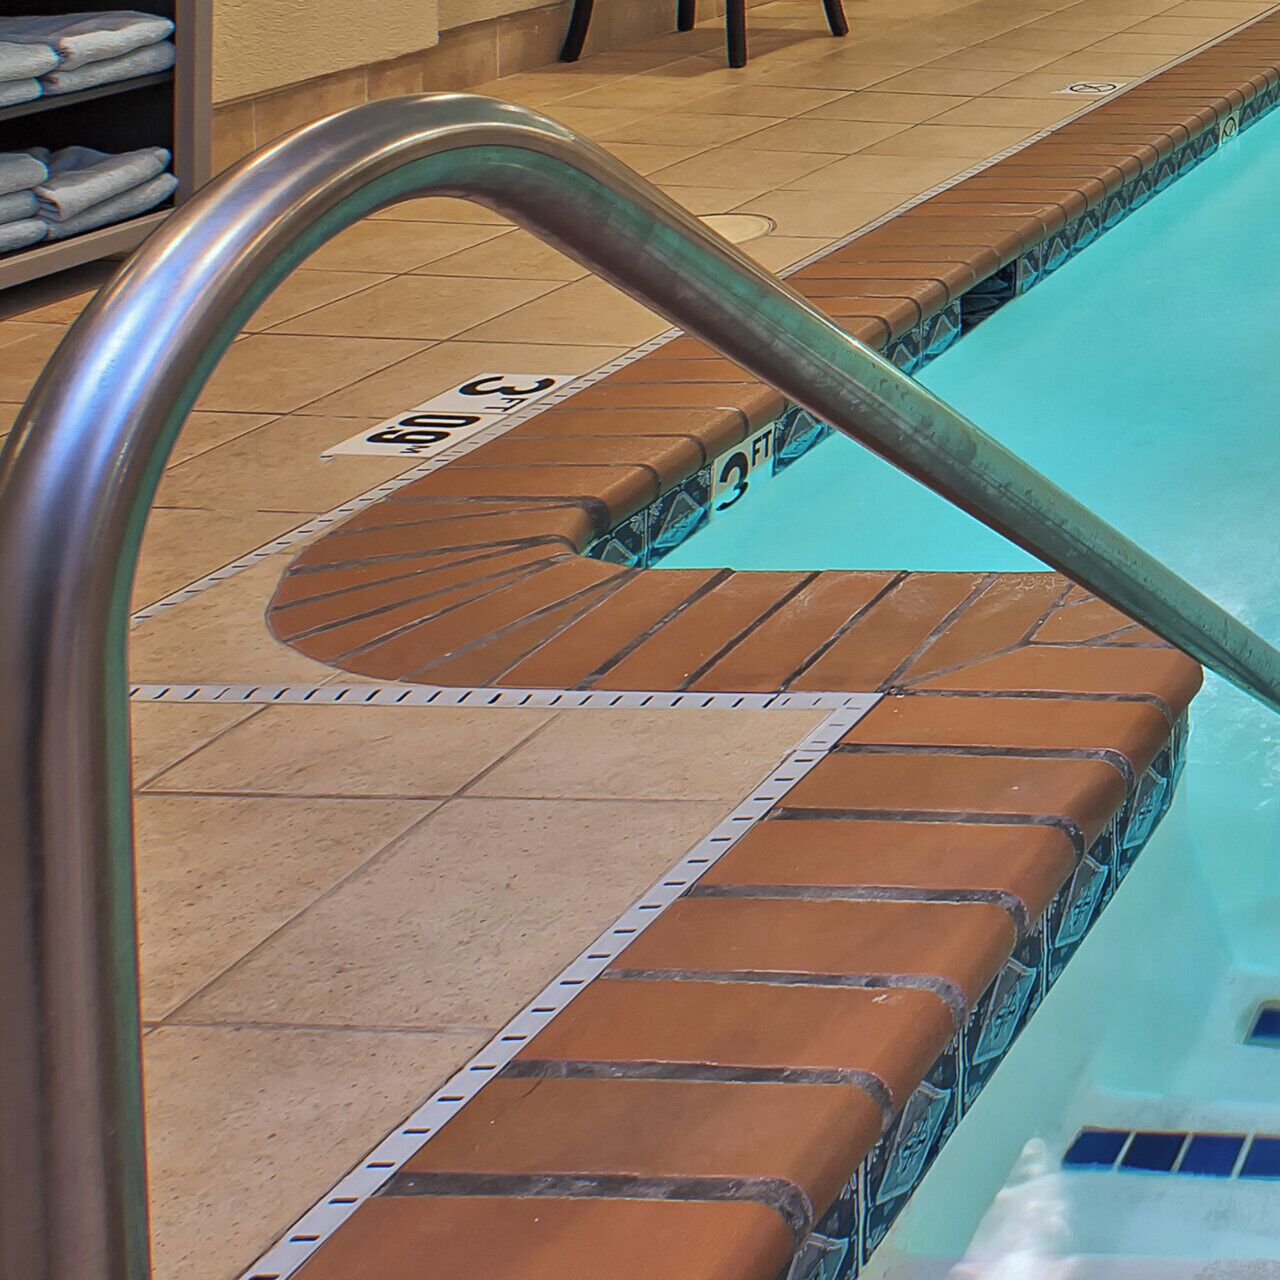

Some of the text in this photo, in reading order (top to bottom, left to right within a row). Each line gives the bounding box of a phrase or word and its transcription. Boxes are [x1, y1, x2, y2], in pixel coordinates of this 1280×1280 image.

[458, 375, 556, 412] 3 FT
[715, 428, 773, 511] 3 FT
